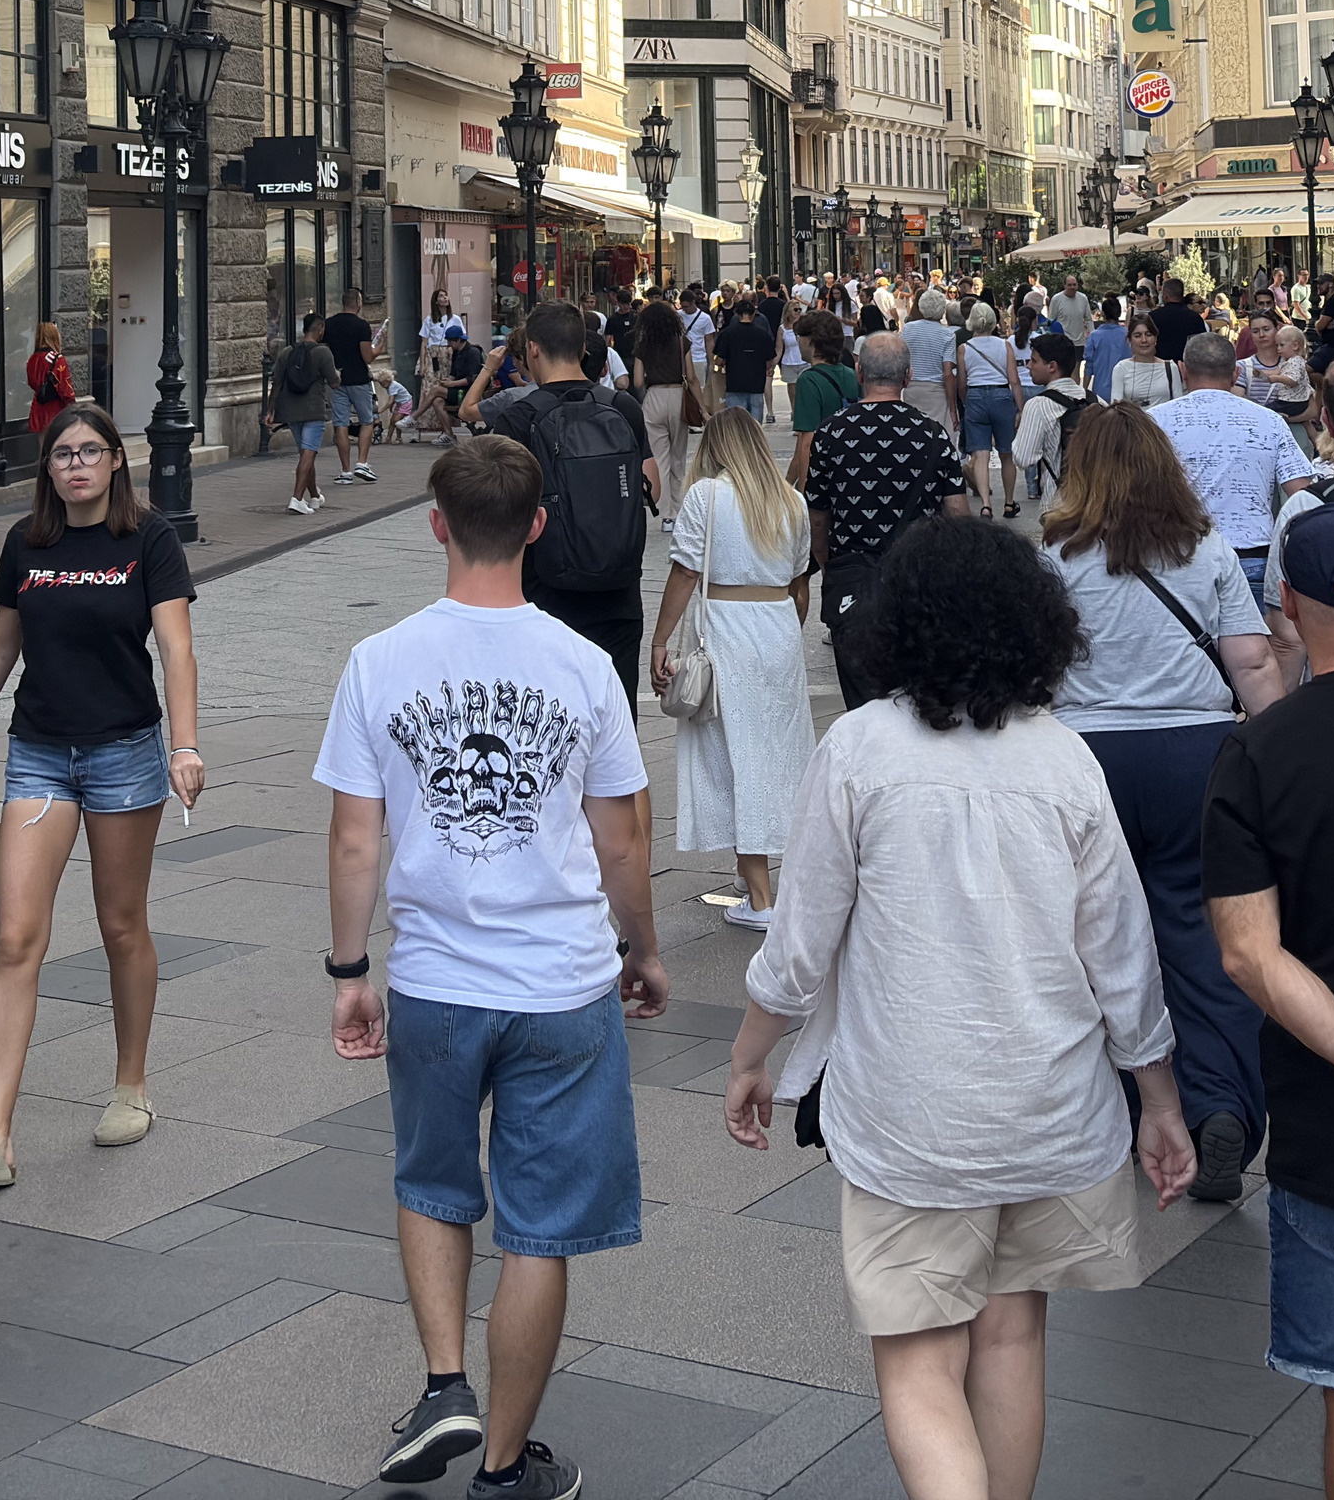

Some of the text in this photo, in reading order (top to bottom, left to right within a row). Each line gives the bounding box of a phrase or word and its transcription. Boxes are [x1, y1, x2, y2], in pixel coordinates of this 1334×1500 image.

[633, 38, 678, 61] ZARA
[548, 74, 580, 89] LEGO
[1132, 78, 1169, 97] BURGER
[1134, 86, 1170, 109] KING
[1227, 158, 1277, 174] anna
[1195, 226, 1243, 237] anna café
[424, 238, 457, 255] CALZEDONIA
[618, 463, 630, 498] THULE
